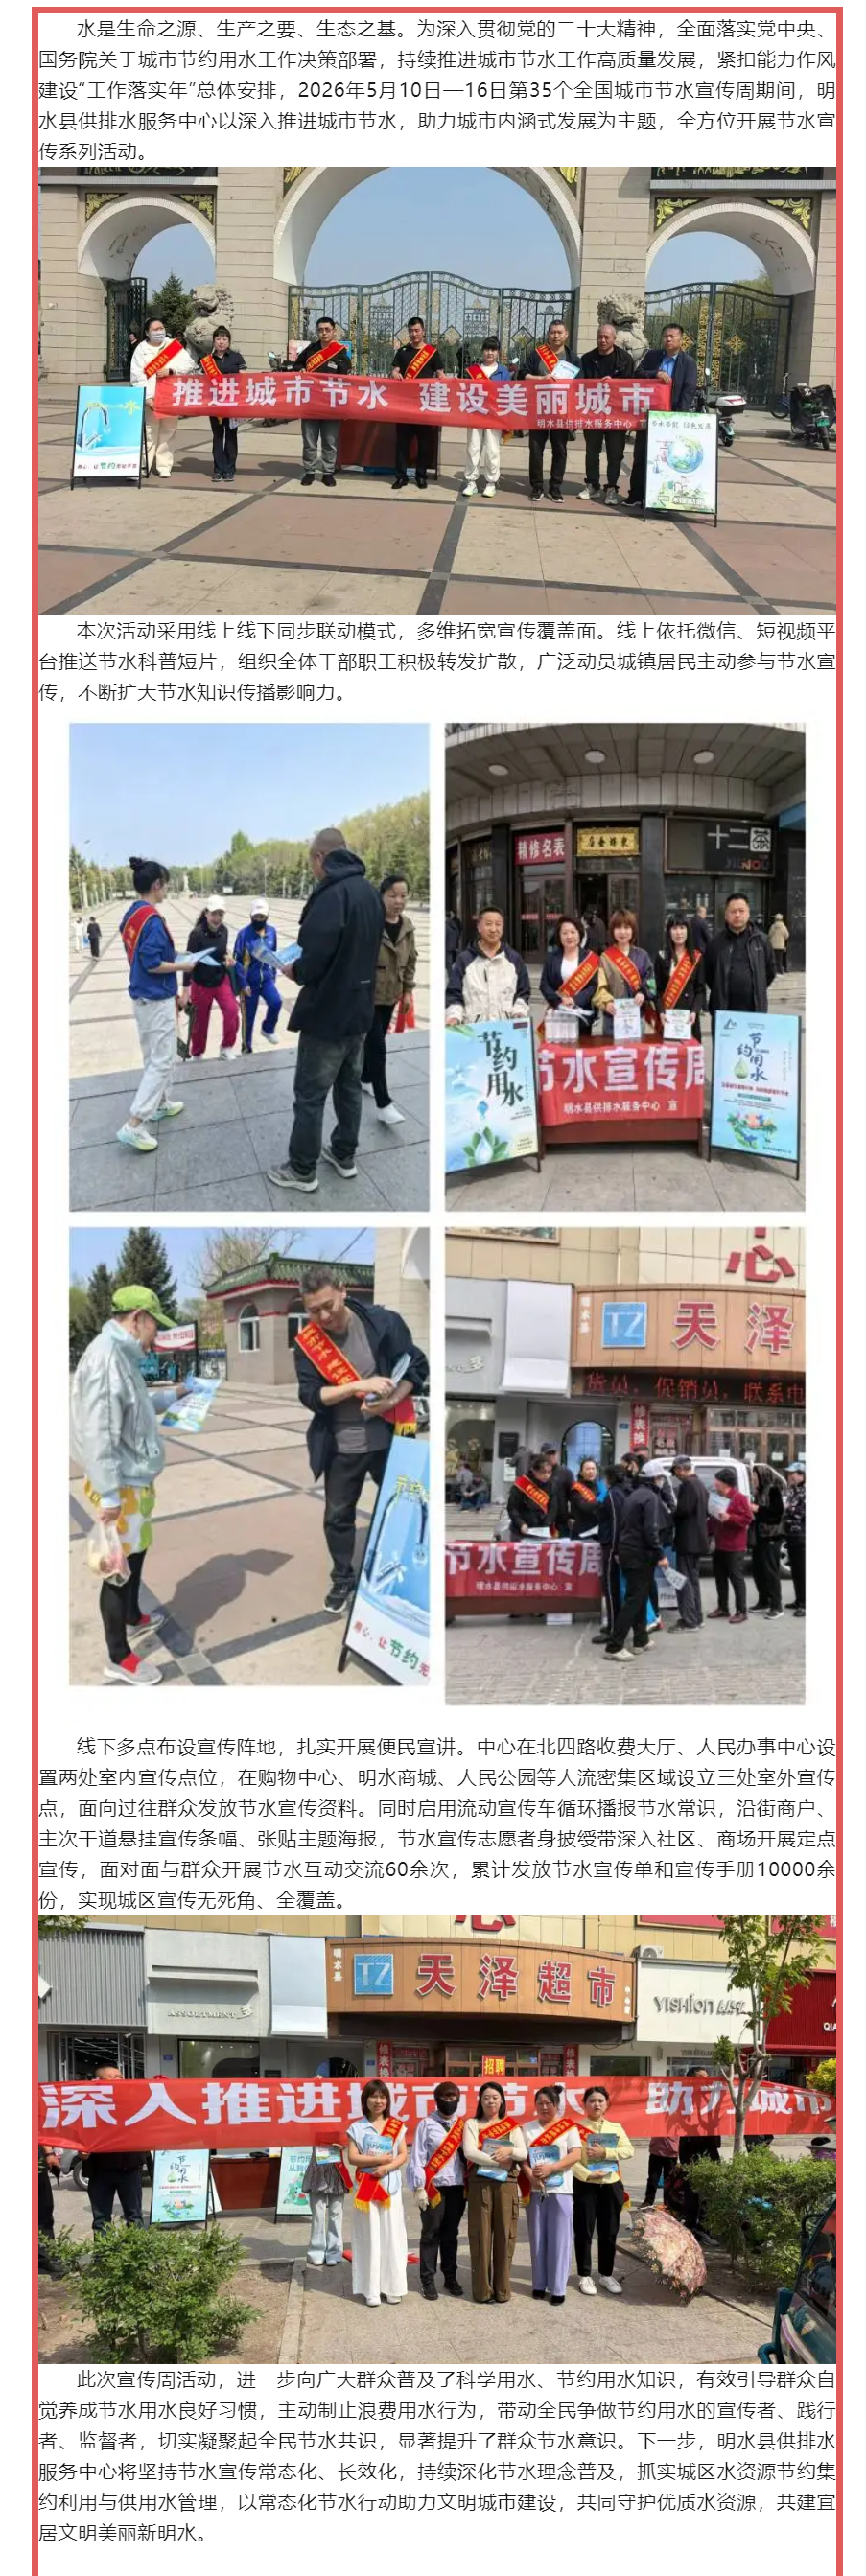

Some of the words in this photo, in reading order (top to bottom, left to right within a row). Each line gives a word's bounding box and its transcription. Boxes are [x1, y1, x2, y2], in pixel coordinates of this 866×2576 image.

[172, 375, 388, 410] 推进城市节水
[419, 382, 654, 416] 建设美丽城市
[537, 419, 632, 429] 明水县供排水服务中心
[518, 838, 565, 860] 精修名表
[478, 1031, 524, 1106] 节约用水
[737, 1032, 768, 1081] 节约用水
[672, 1301, 794, 1355] 天泽
[416, 1953, 617, 2007] 天泽超市
[484, 2058, 505, 2076] 招聘
